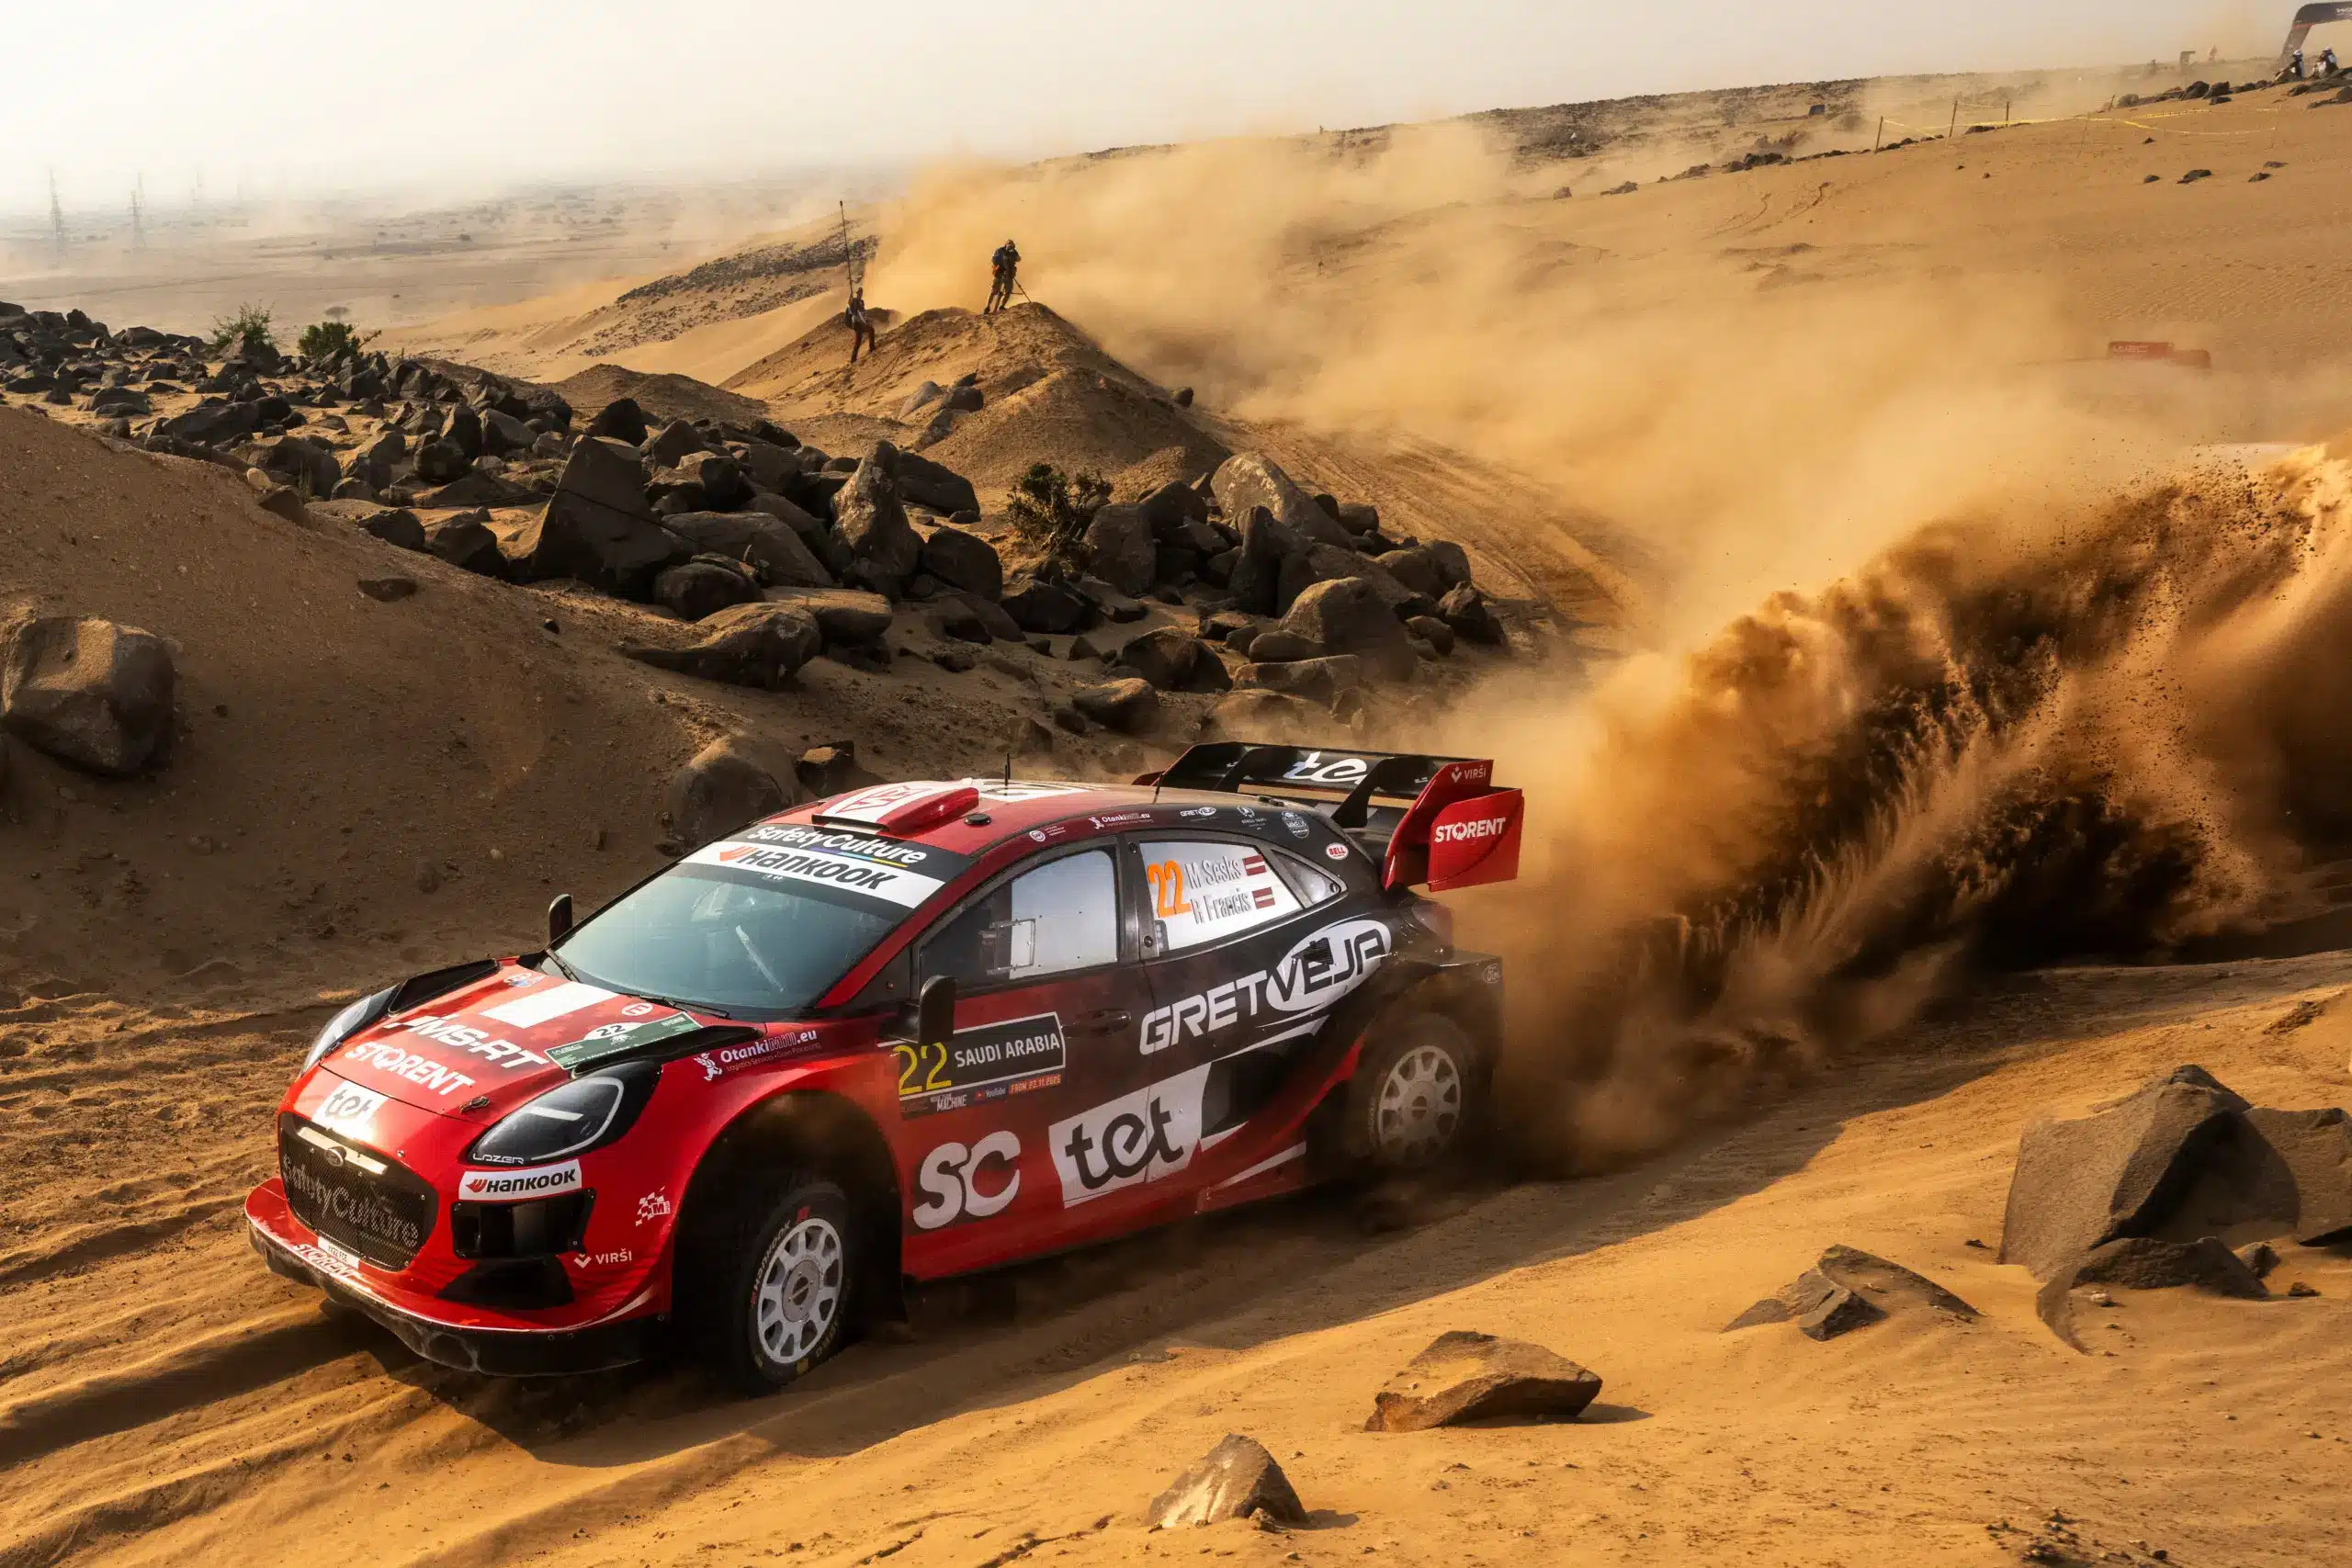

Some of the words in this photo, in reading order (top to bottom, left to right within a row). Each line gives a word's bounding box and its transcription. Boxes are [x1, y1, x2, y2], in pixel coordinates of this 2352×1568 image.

[1283, 751, 1368, 785] te
[1464, 765, 1487, 780] VIRŠI
[747, 826, 927, 864] SafetyCulture
[1434, 817, 1507, 843] STORENT
[1329, 846, 1346, 856] BELL
[1148, 860, 1192, 919] 22
[1184, 863, 1202, 890] M
[1201, 855, 1241, 885] Sesks
[1204, 887, 1252, 921] Francis
[1139, 928, 1391, 1055] GRETVEJA
[595, 1024, 626, 1037] 22
[345, 1041, 477, 1096] STORENT
[892, 1042, 953, 1096] 22
[954, 1044, 1002, 1068] SAUDI
[1005, 1032, 1061, 1059] ARABIA
[936, 1094, 967, 1112] MACHINE
[986, 1088, 1007, 1099] YouTube
[472, 1153, 525, 1165] LAZER
[1064, 1096, 1183, 1190] tet
[912, 1130, 1022, 1230] SC
[594, 1247, 633, 1266] VIRŠI
